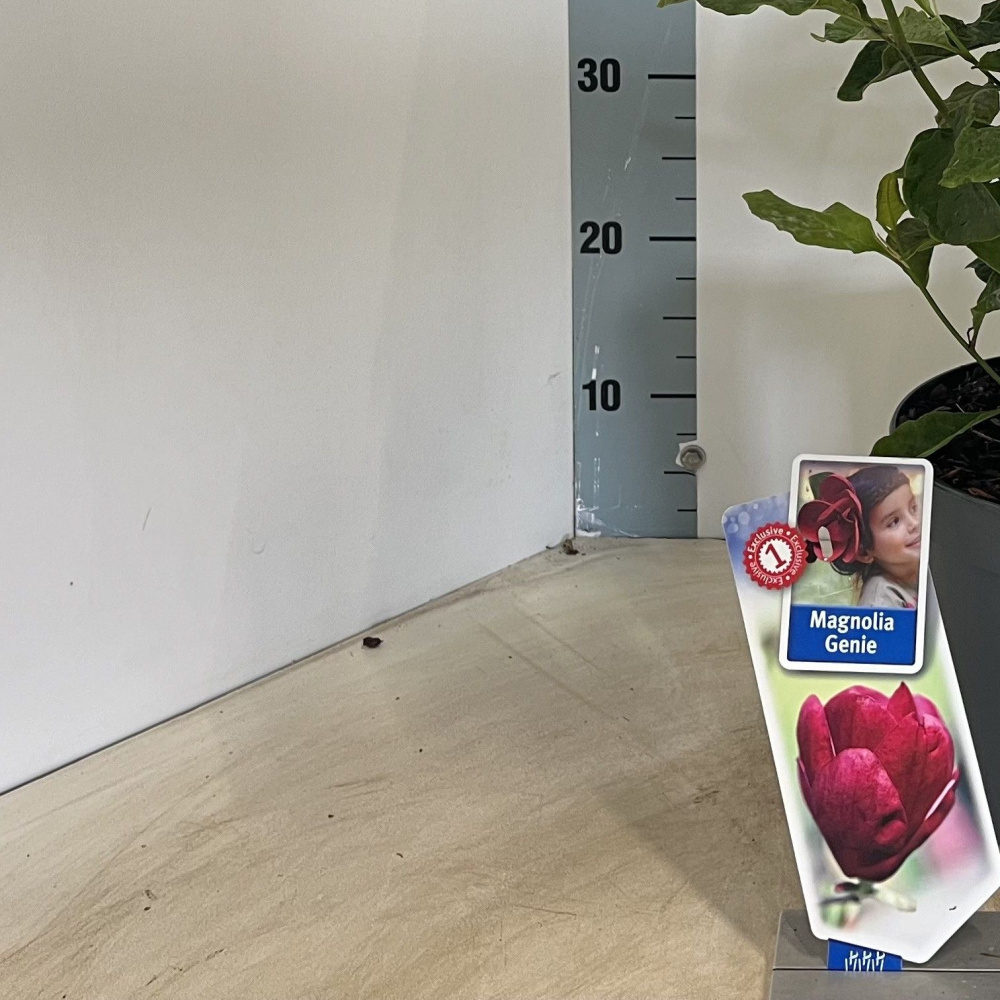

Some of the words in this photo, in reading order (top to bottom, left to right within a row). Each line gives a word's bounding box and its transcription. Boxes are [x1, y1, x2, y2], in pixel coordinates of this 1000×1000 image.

[577, 57, 621, 93] 30
[579, 220, 623, 255] 20
[581, 378, 621, 412] 10
[747, 526, 784, 553] Exclusive
[764, 543, 787, 569] 1
[790, 534, 805, 575] Exclusive
[750, 561, 784, 586] Exclusive
[809, 610, 895, 634] Magnolia
[825, 634, 878, 655] Genie
